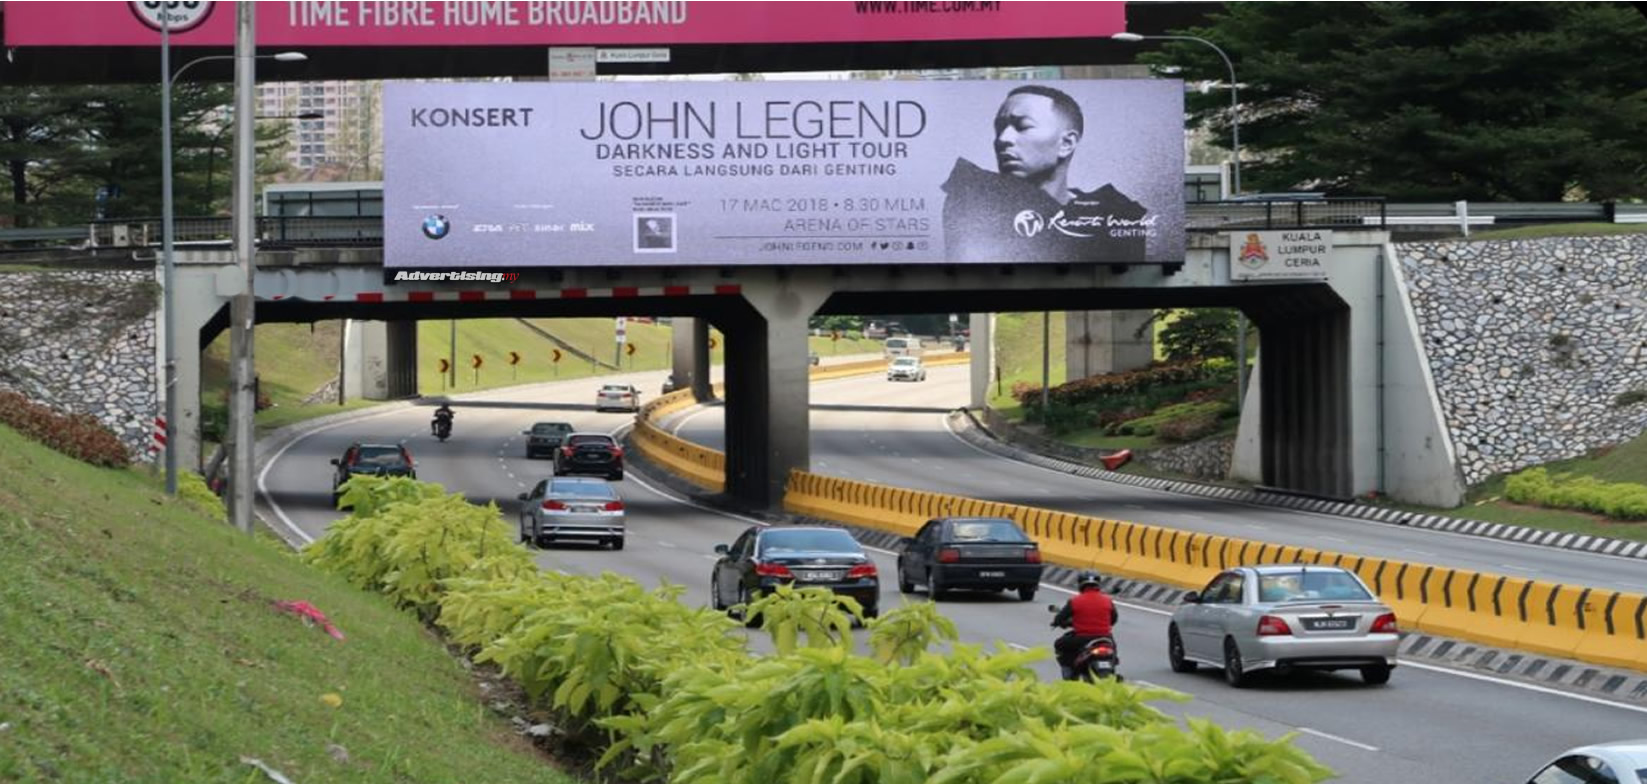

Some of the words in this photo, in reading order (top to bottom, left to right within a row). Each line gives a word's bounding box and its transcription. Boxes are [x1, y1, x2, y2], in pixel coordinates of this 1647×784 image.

[288, 1, 349, 26] TIME
[358, 1, 435, 26] FIBRE
[444, 1, 520, 26] HOME
[527, 1, 687, 25] BROADBAND
[411, 107, 534, 128] KONSERT
[580, 100, 716, 141] JOHN
[736, 100, 928, 140] LEGEND
[595, 142, 715, 160] DARKNESS
[722, 142, 768, 160] AND
[776, 141, 841, 159] LIGHT
[848, 141, 908, 159] TOUR
[613, 164, 678, 177] SECARA
[684, 163, 774, 177] LANGSUNG
[780, 163, 818, 176] DARI
[824, 163, 897, 176] GENTING
[720, 199, 738, 213] 17
[744, 198, 781, 213] MAC
[786, 198, 829, 212] 2018
[784, 218, 842, 232] ARENA
[848, 218, 871, 231] OF
[875, 217, 931, 231] STARS
[1110, 228, 1157, 237] GENTING
[1282, 232, 1322, 242] KUALA
[1278, 245, 1326, 255] LUMPUR
[1285, 258, 1321, 267] CERIA
